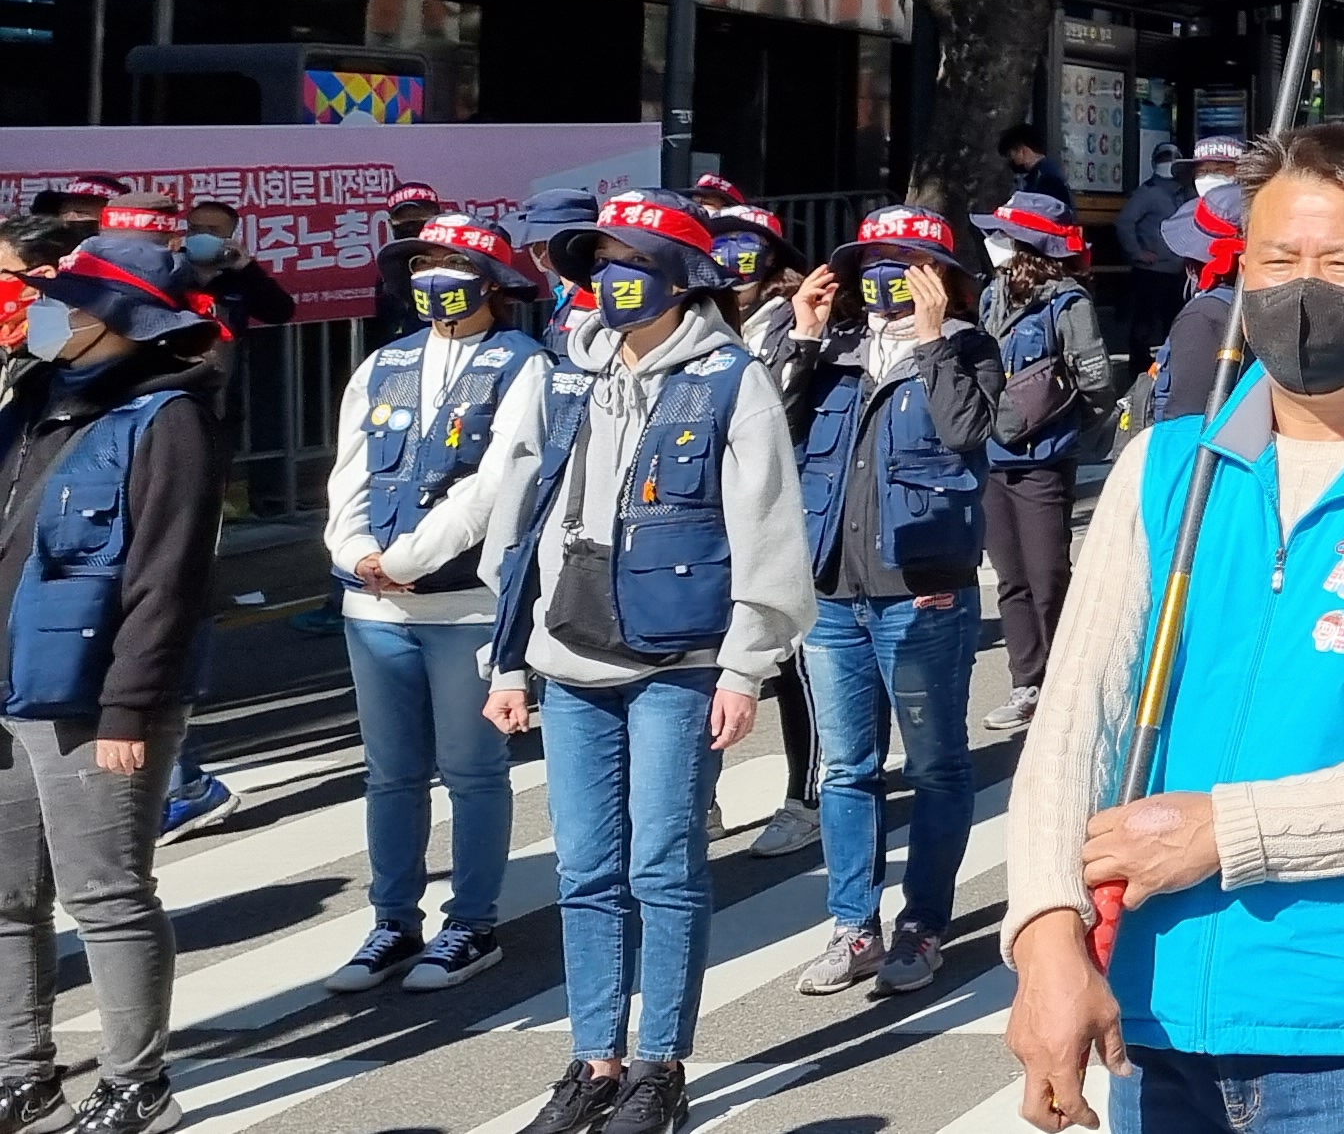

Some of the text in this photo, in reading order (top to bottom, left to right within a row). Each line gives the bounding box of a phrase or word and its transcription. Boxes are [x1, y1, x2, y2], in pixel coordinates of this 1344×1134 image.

[191, 171, 317, 209] 평등사회로
[237, 209, 397, 273] 주노총
[413, 287, 468, 315] 단결
